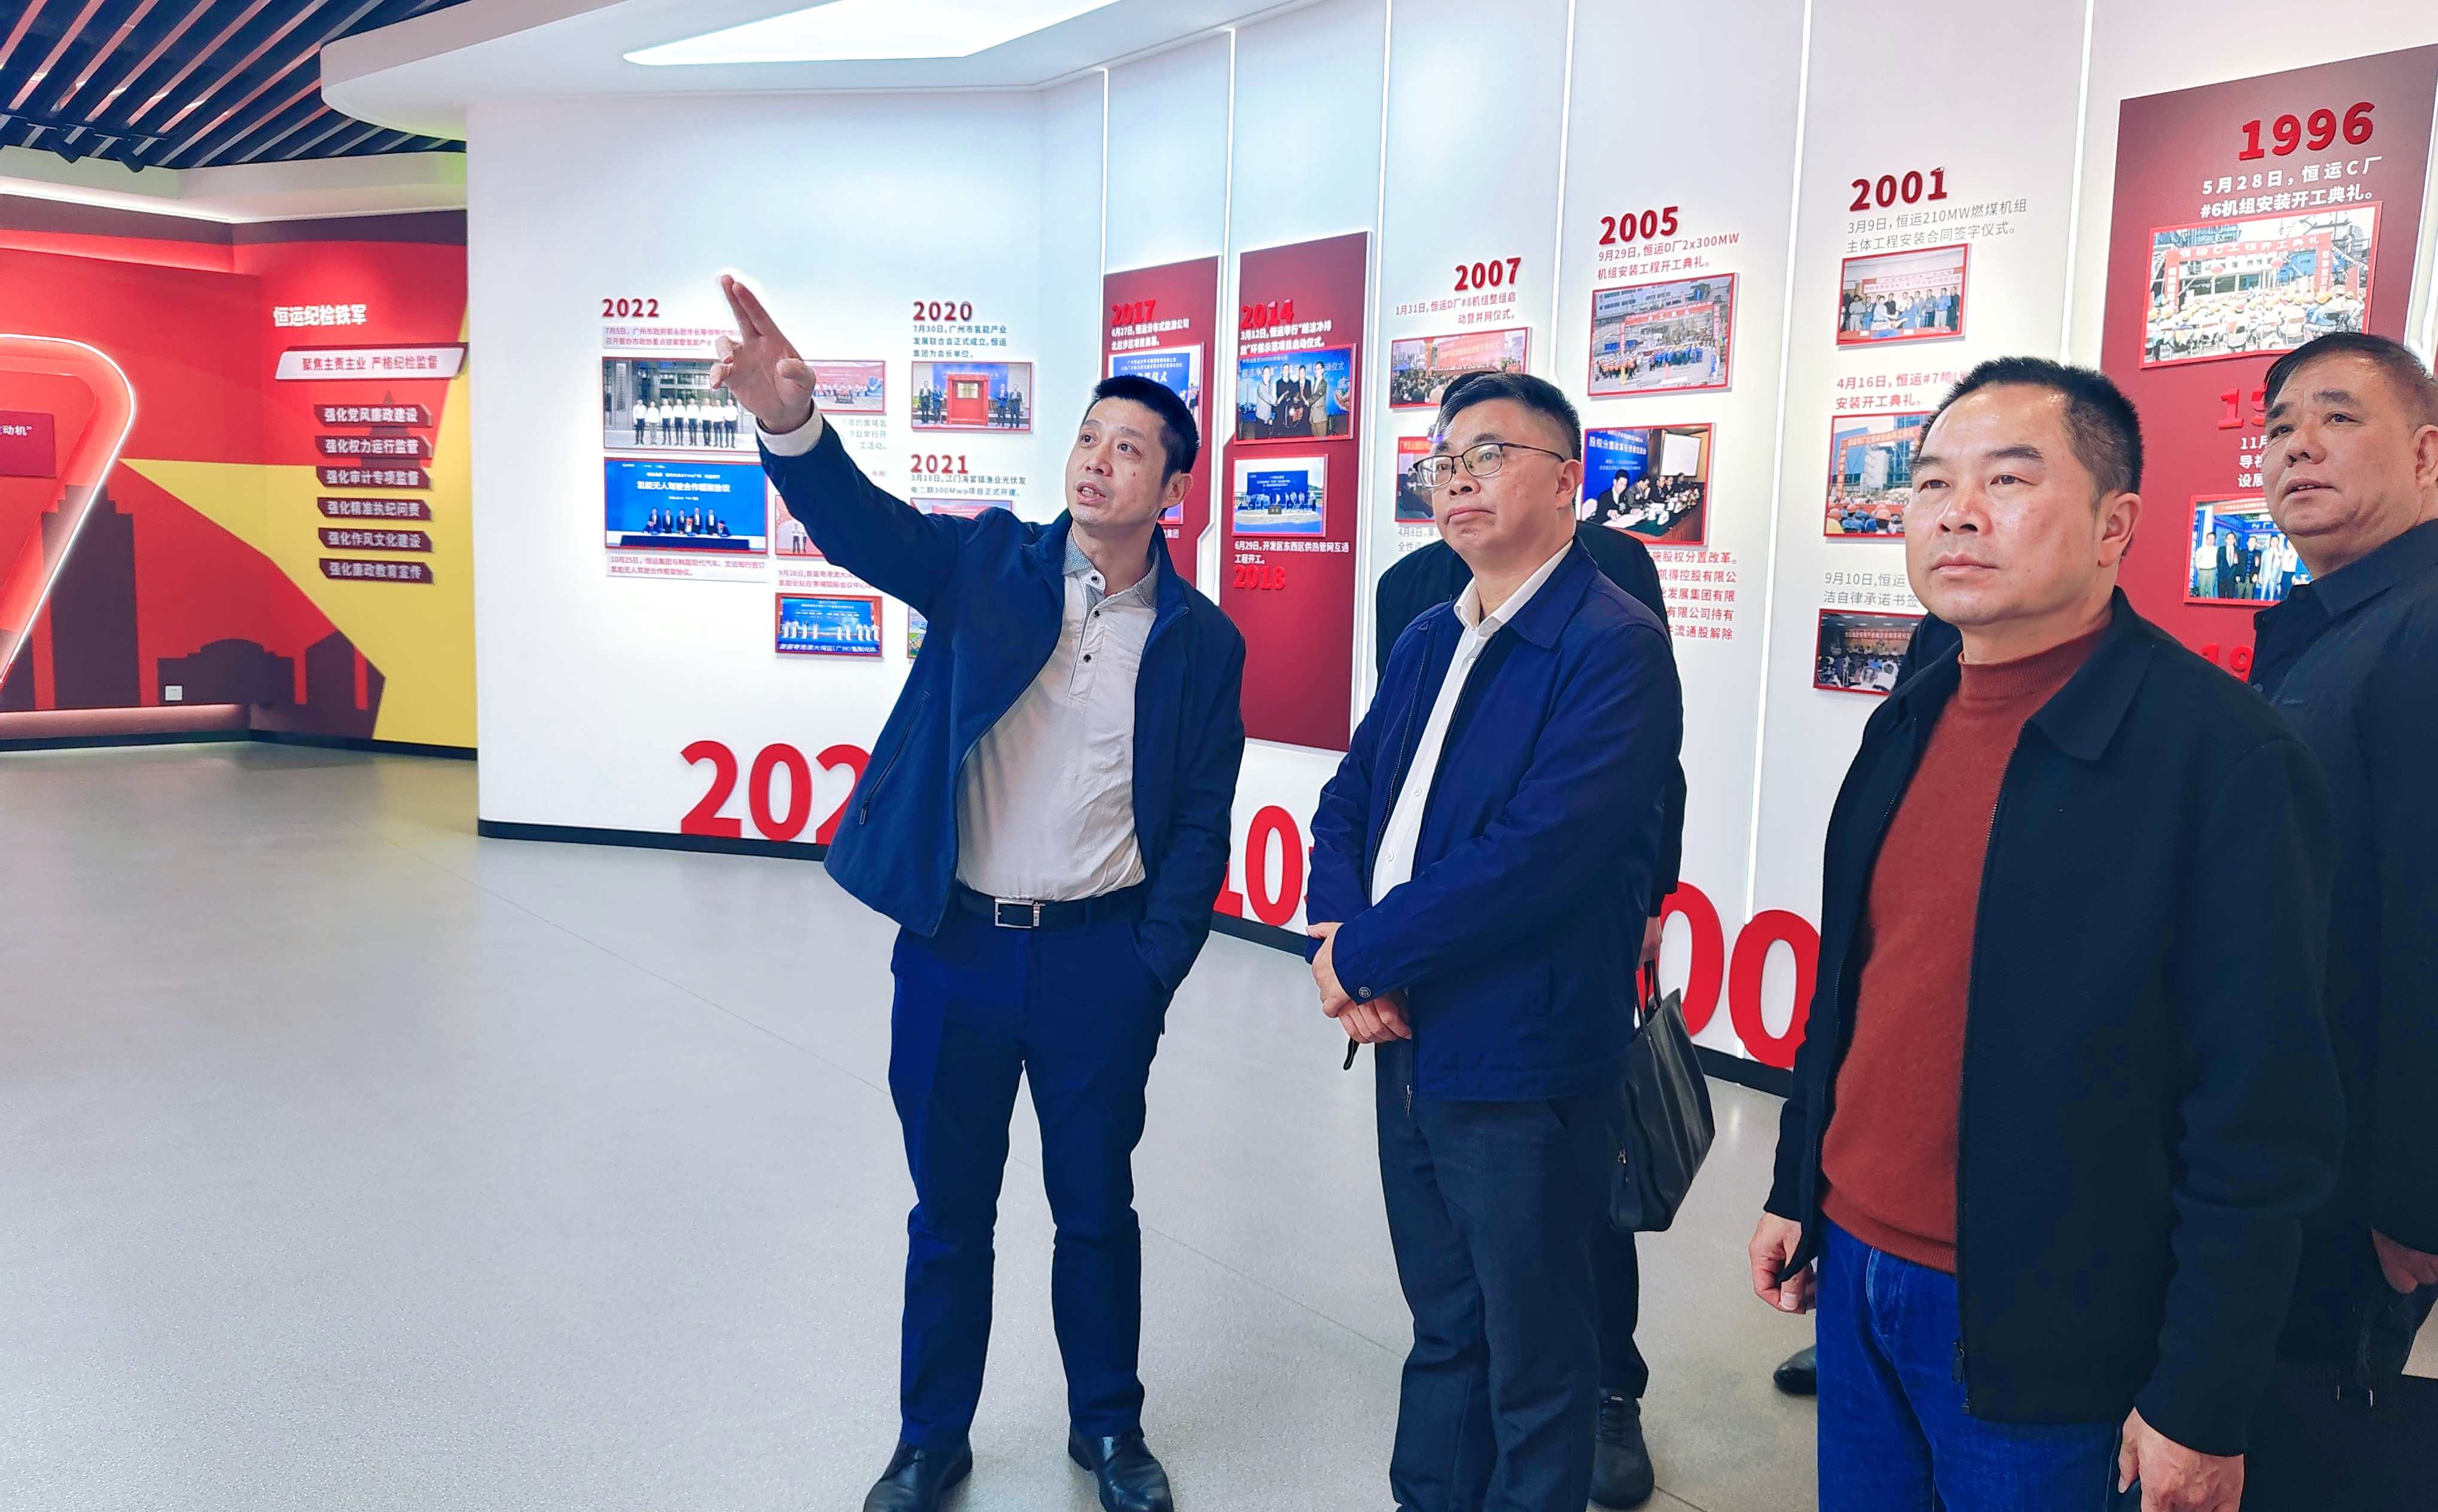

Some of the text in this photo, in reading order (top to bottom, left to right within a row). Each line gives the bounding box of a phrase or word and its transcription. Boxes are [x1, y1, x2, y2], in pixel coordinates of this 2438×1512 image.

[2239, 101, 2375, 161] 1996
[1849, 166, 1948, 212] 2001
[2200, 183, 2372, 218] #6机组安装开工典礼。
[1599, 206, 1678, 245] 2005
[1848, 199, 2026, 233] 3月9日，恒运210MW燃煤机组
[1846, 221, 2015, 254] 主体工程安装合同签字仪式。
[1454, 257, 1522, 291] 2007
[1598, 255, 1709, 280] 机组安装工程开工典礼。
[273, 304, 367, 327] 恒运纪检铁军
[602, 298, 660, 318] 2022
[913, 301, 973, 321] 2020
[1111, 299, 1156, 327] 2017
[1240, 299, 1294, 329] 2014
[1458, 309, 1515, 324] 动暨并网仪式。
[1111, 336, 1160, 351] 北起步区项目奠基。
[302, 355, 438, 371] 聚焦主责主业 严格纪检监督
[1836, 393, 1921, 410] 安装开工典礼。
[324, 407, 418, 423] 强化党风廉政建设
[325, 438, 419, 454] 强化权力运行监管
[910, 454, 969, 474] 2021
[326, 470, 419, 486] 强化审计专项监督
[328, 531, 422, 548] 强化作风文化建设
[1235, 541, 1349, 553] 6月29日，开发区东西区供热管网互通
[1235, 554, 1265, 564] 工程开工。
[1647, 551, 1737, 565] 施股权分置改革。
[1233, 565, 1285, 590] 2018
[1824, 590, 1919, 608] 洁自律承诺书签
